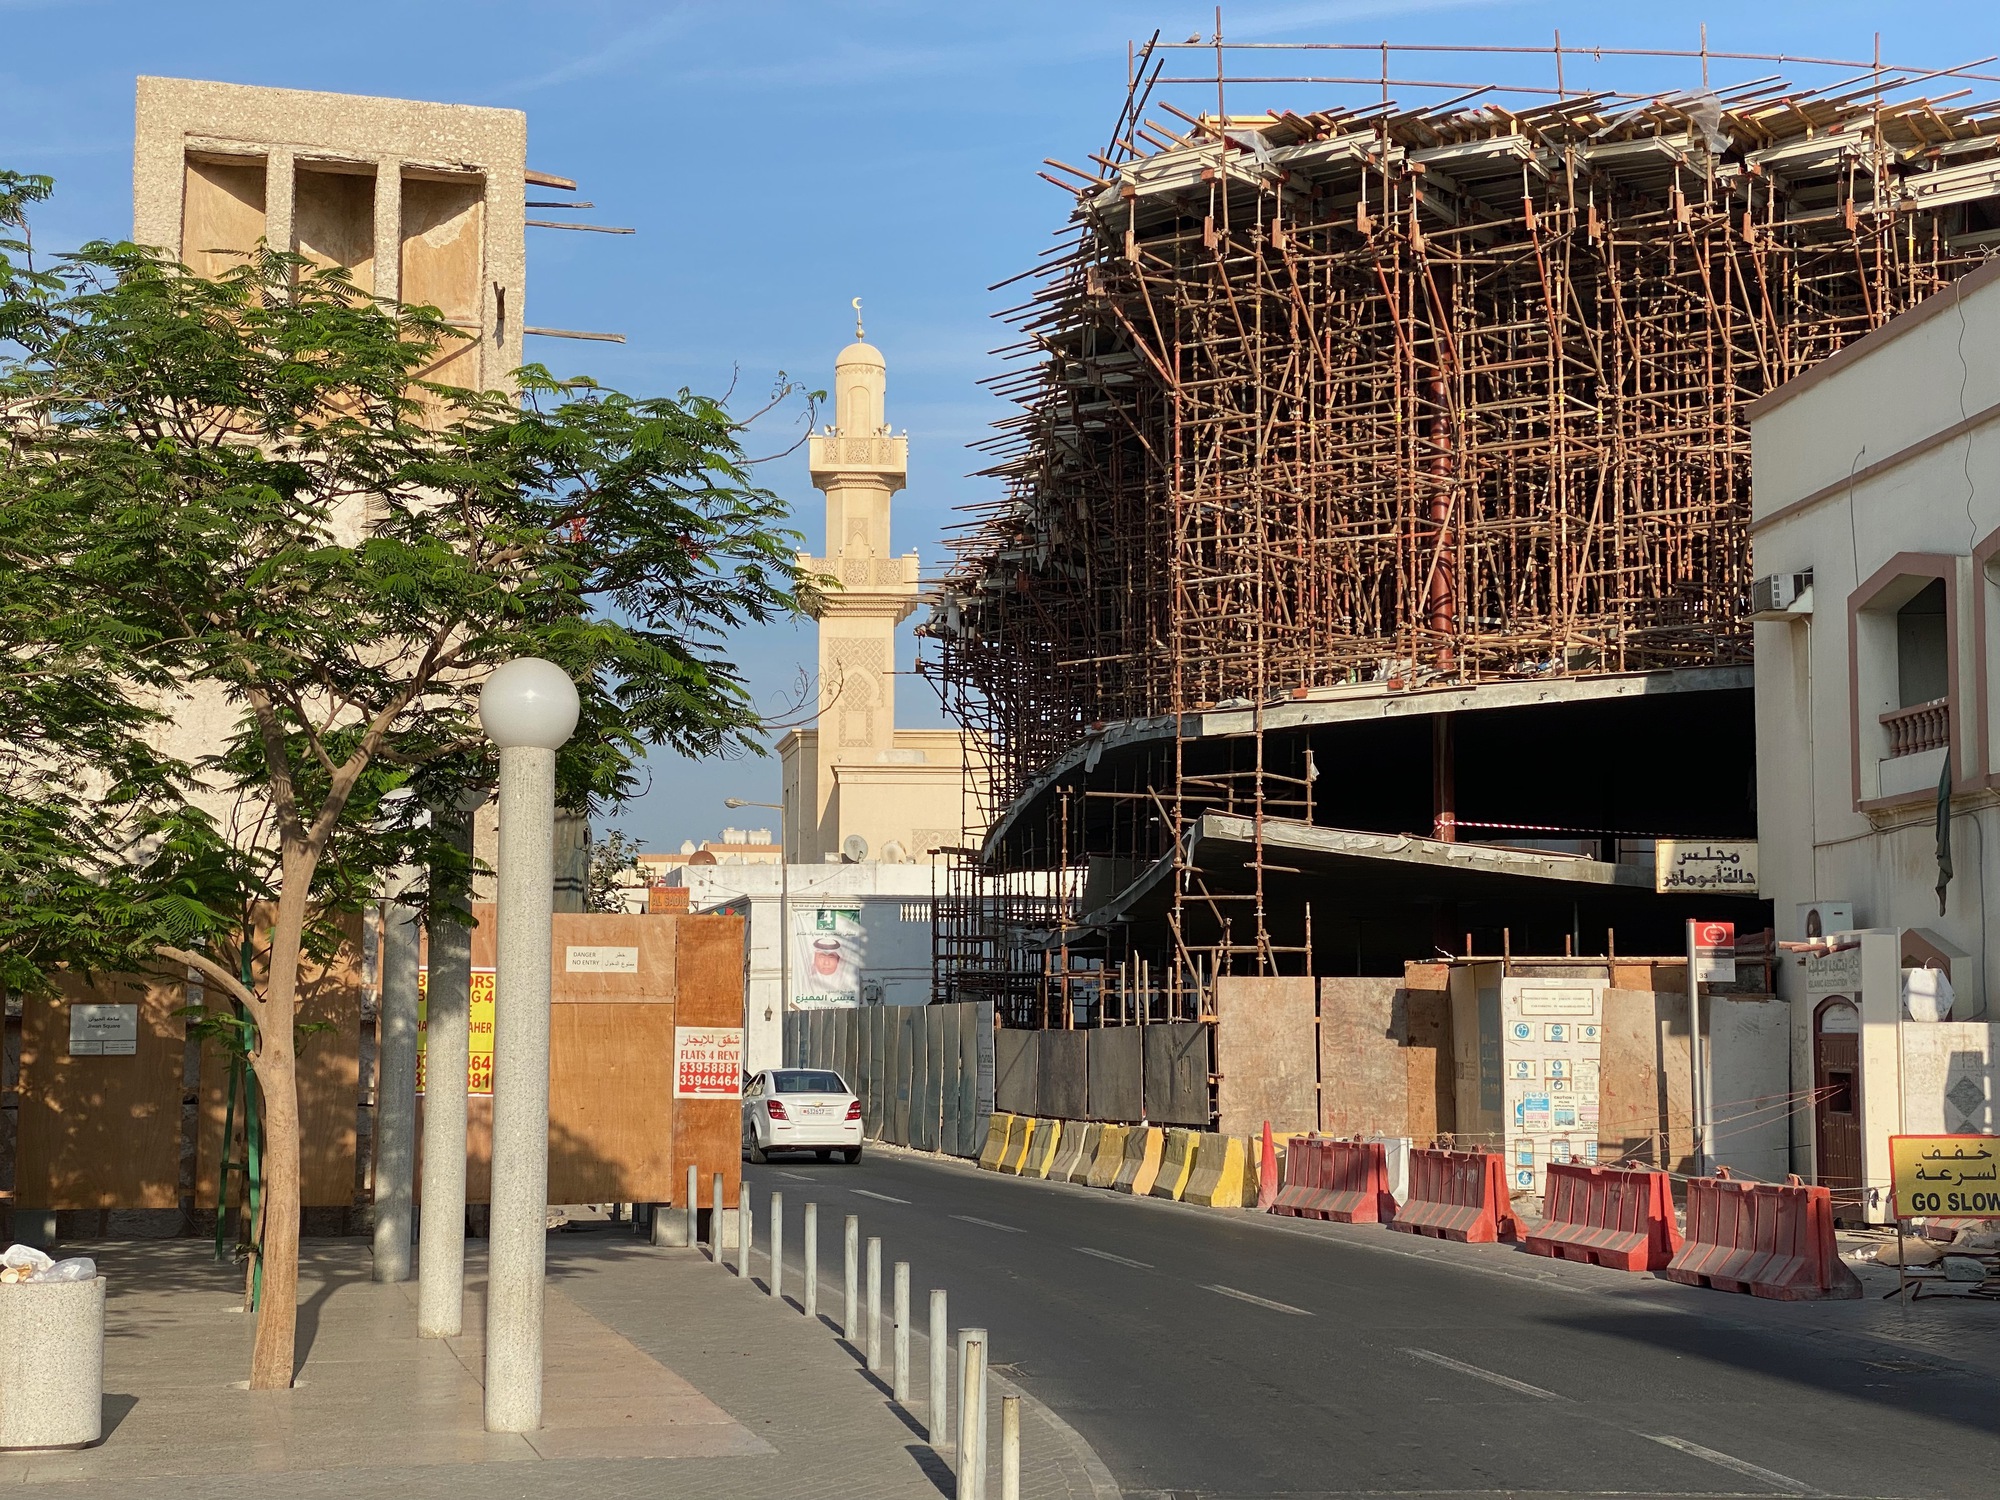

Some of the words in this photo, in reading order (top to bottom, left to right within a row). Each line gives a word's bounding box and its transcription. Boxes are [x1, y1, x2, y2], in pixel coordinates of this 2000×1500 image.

[1677, 846, 1740, 865] مجلس
[822, 910, 833, 924] 4
[484, 990, 493, 1003] 4
[717, 1034, 740, 1048] شقق
[680, 1050, 706, 1060] FLATS
[709, 1051, 714, 1060] 4
[717, 1051, 740, 1060] RENT
[681, 1062, 739, 1074] 33958881
[680, 1075, 739, 1086] 33946464
[1921, 1143, 1992, 1160] خفف
[1915, 1163, 1997, 1186] لسرعة
[1911, 1193, 1940, 1211] GO
[1947, 1193, 2000, 1211] SLOW
